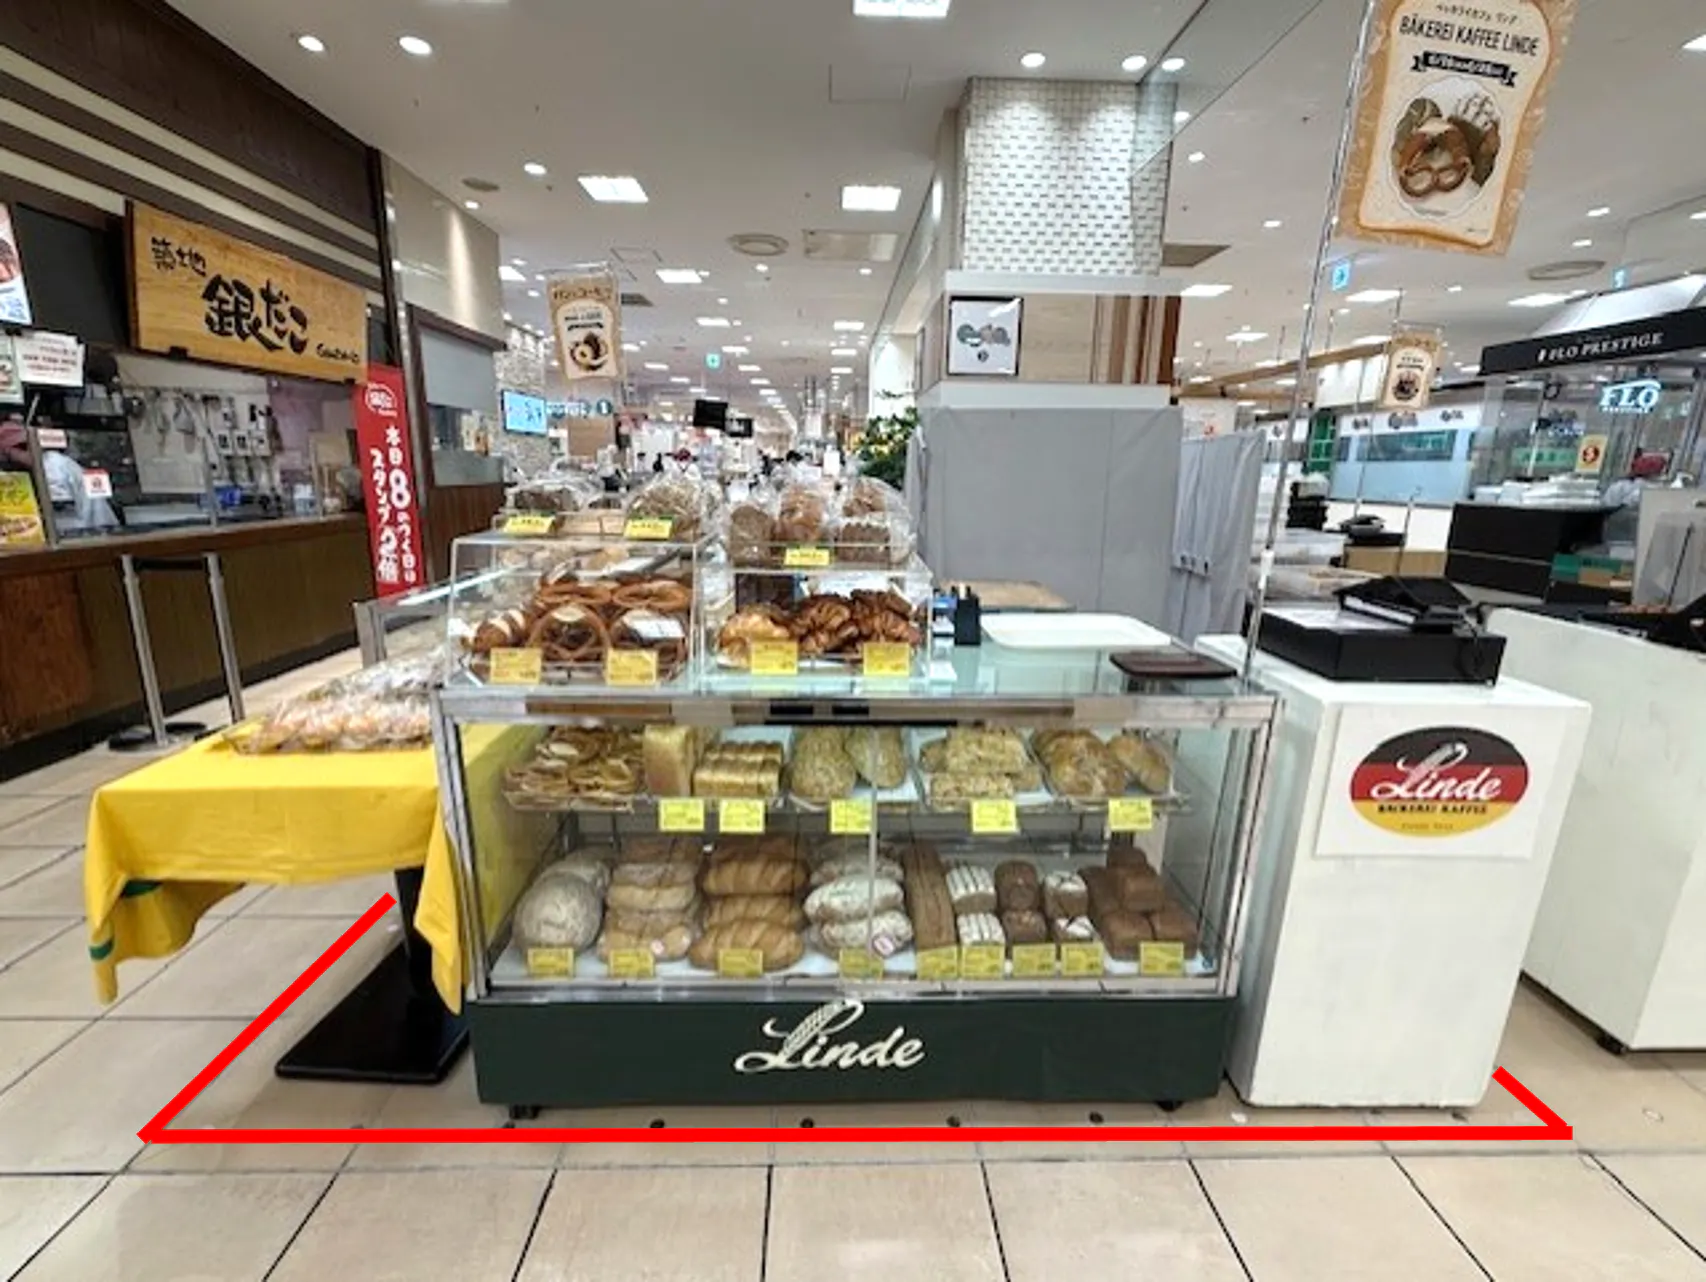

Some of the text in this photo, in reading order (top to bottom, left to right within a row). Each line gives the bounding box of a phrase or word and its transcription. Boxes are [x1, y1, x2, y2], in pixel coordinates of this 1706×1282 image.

[1455, 25, 1502, 49] KAFFEE
[1503, 33, 1541, 56] LINDE
[151, 236, 207, 277] 築地
[202, 274, 308, 354] 銀だこ
[1581, 332, 1664, 356] PRESTIGE
[1600, 379, 1661, 411] FLO
[1370, 742, 1502, 801] Linde
[733, 998, 926, 1073] Linde
